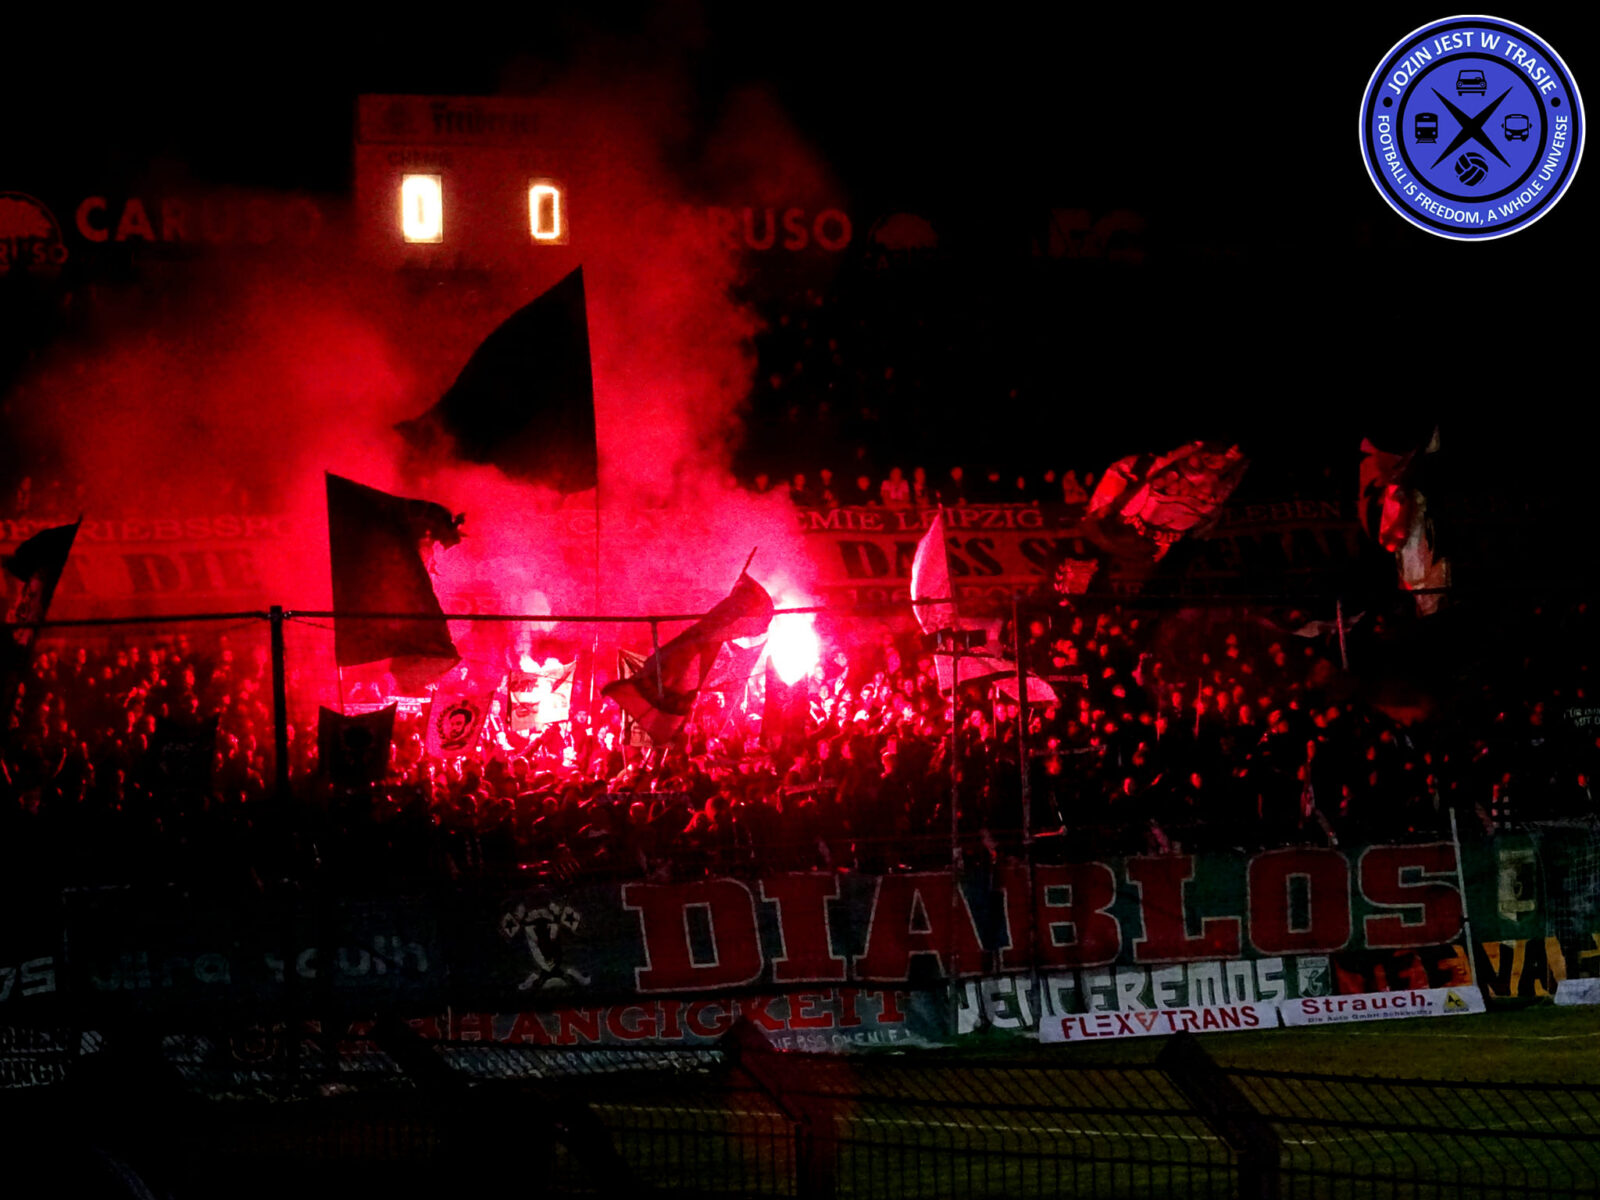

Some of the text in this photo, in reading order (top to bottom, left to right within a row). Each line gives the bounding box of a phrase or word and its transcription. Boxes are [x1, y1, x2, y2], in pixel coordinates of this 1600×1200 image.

[529, 185, 560, 240] 0
[706, 206, 852, 251] RUSO
[620, 840, 1465, 994] DIABLOS
